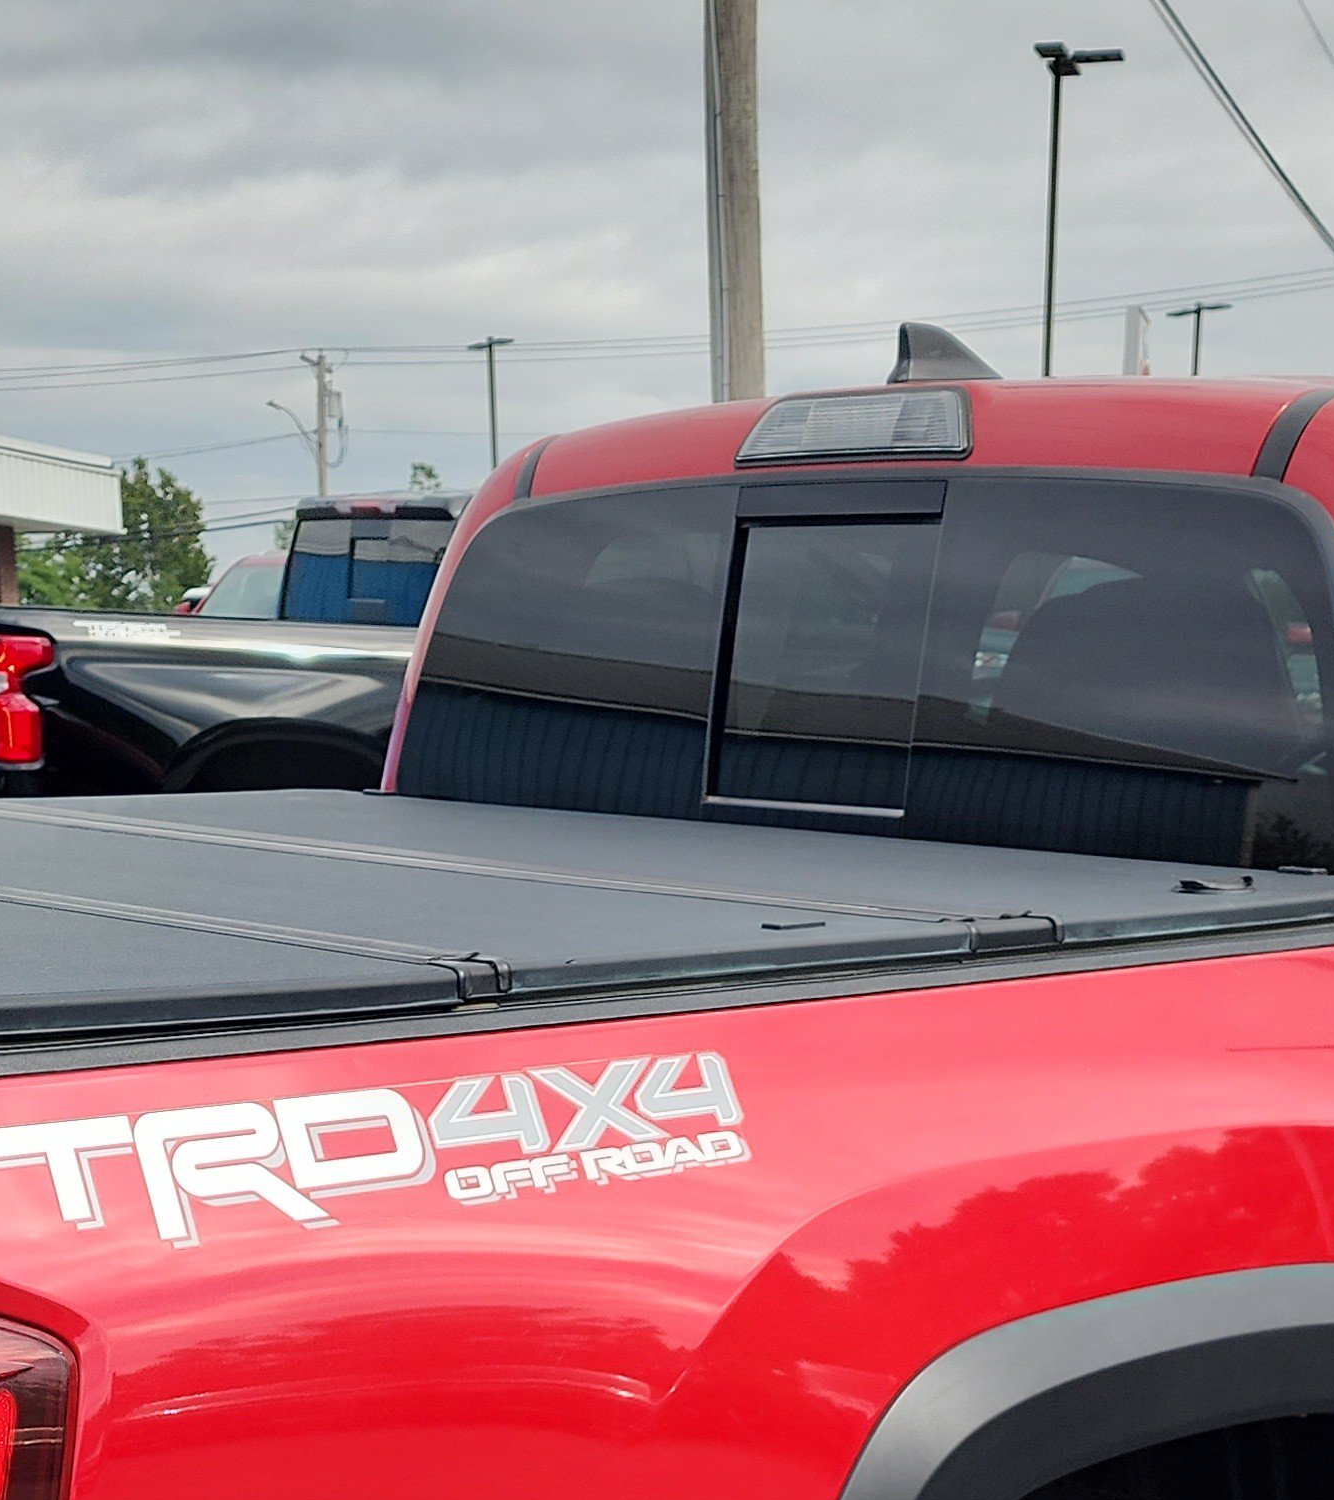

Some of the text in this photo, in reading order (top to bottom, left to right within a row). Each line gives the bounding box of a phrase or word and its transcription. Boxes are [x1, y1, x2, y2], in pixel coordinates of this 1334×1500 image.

[428, 1051, 744, 1155] 4X4
[444, 1130, 751, 1205] OFF ROAD
